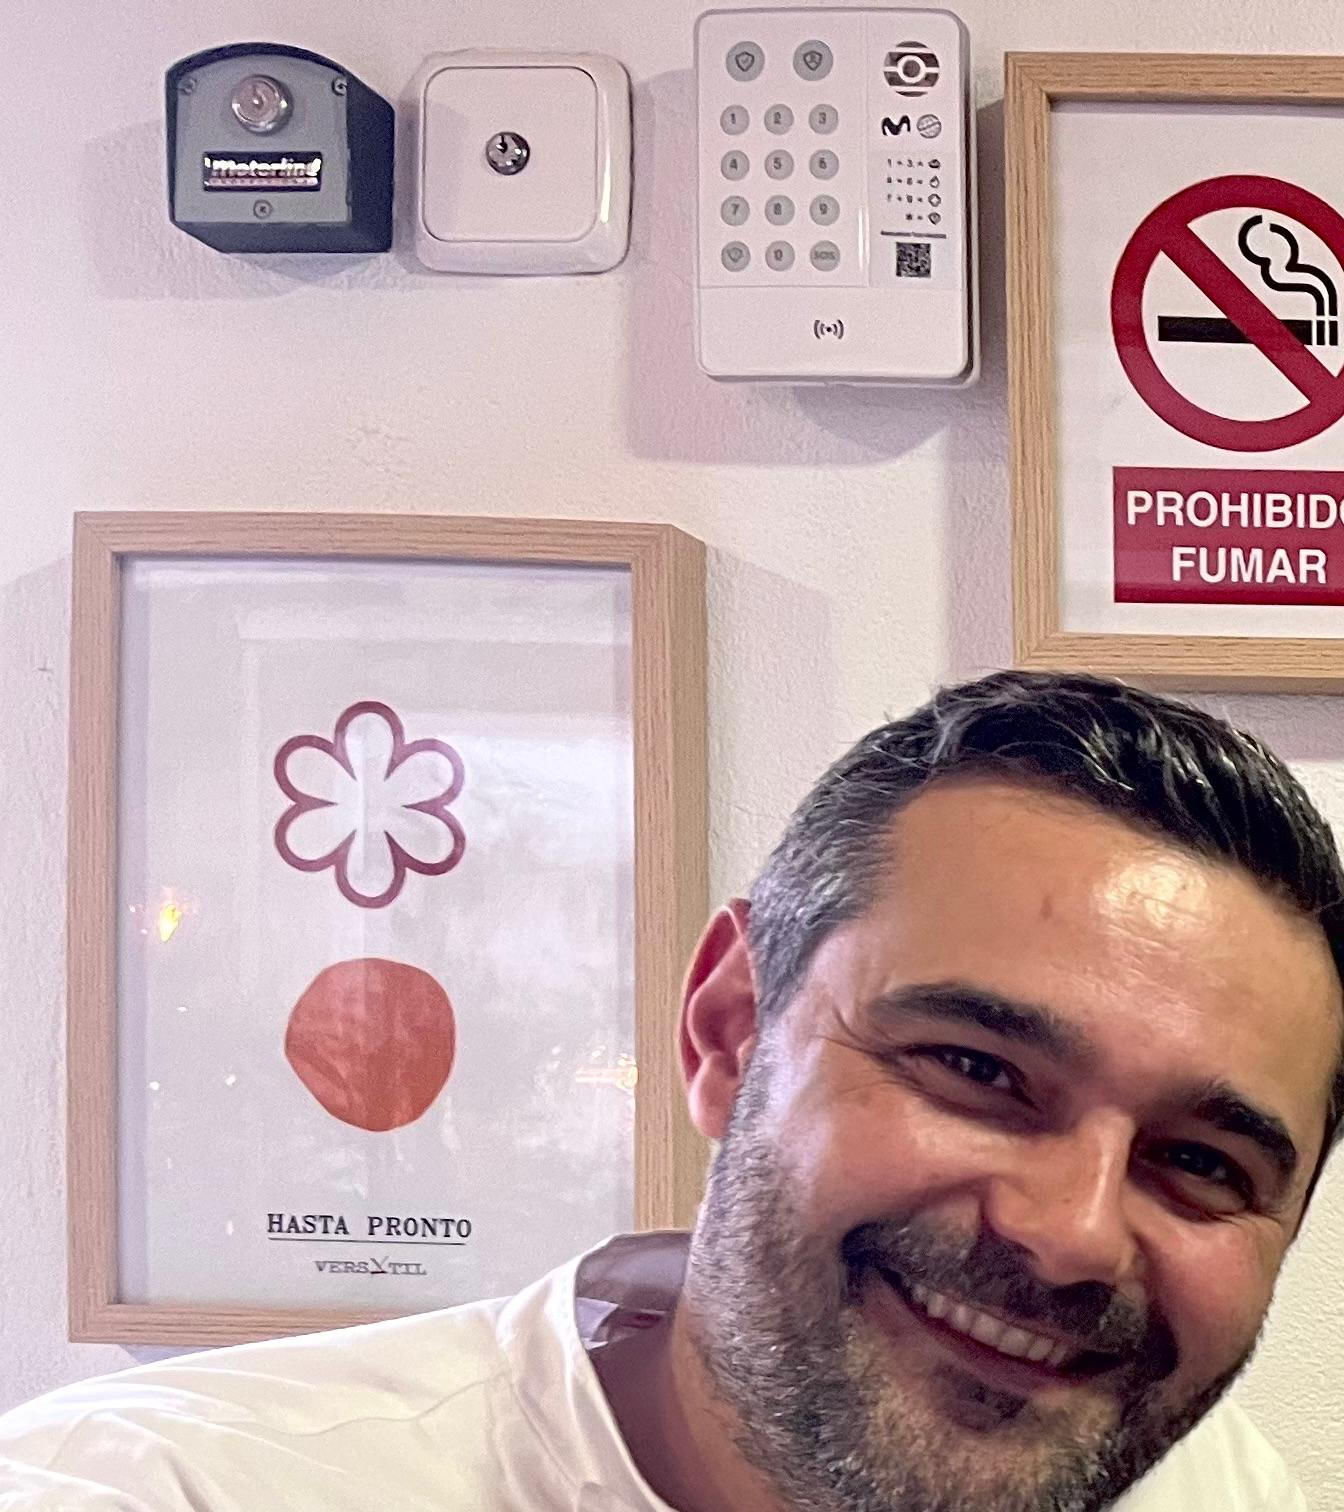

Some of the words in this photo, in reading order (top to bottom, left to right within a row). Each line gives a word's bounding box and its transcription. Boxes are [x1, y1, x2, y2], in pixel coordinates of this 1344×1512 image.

[1172, 546, 1328, 585] FUMAR
[267, 1213, 349, 1235] HASTA
[367, 1215, 472, 1238] PRONTO
